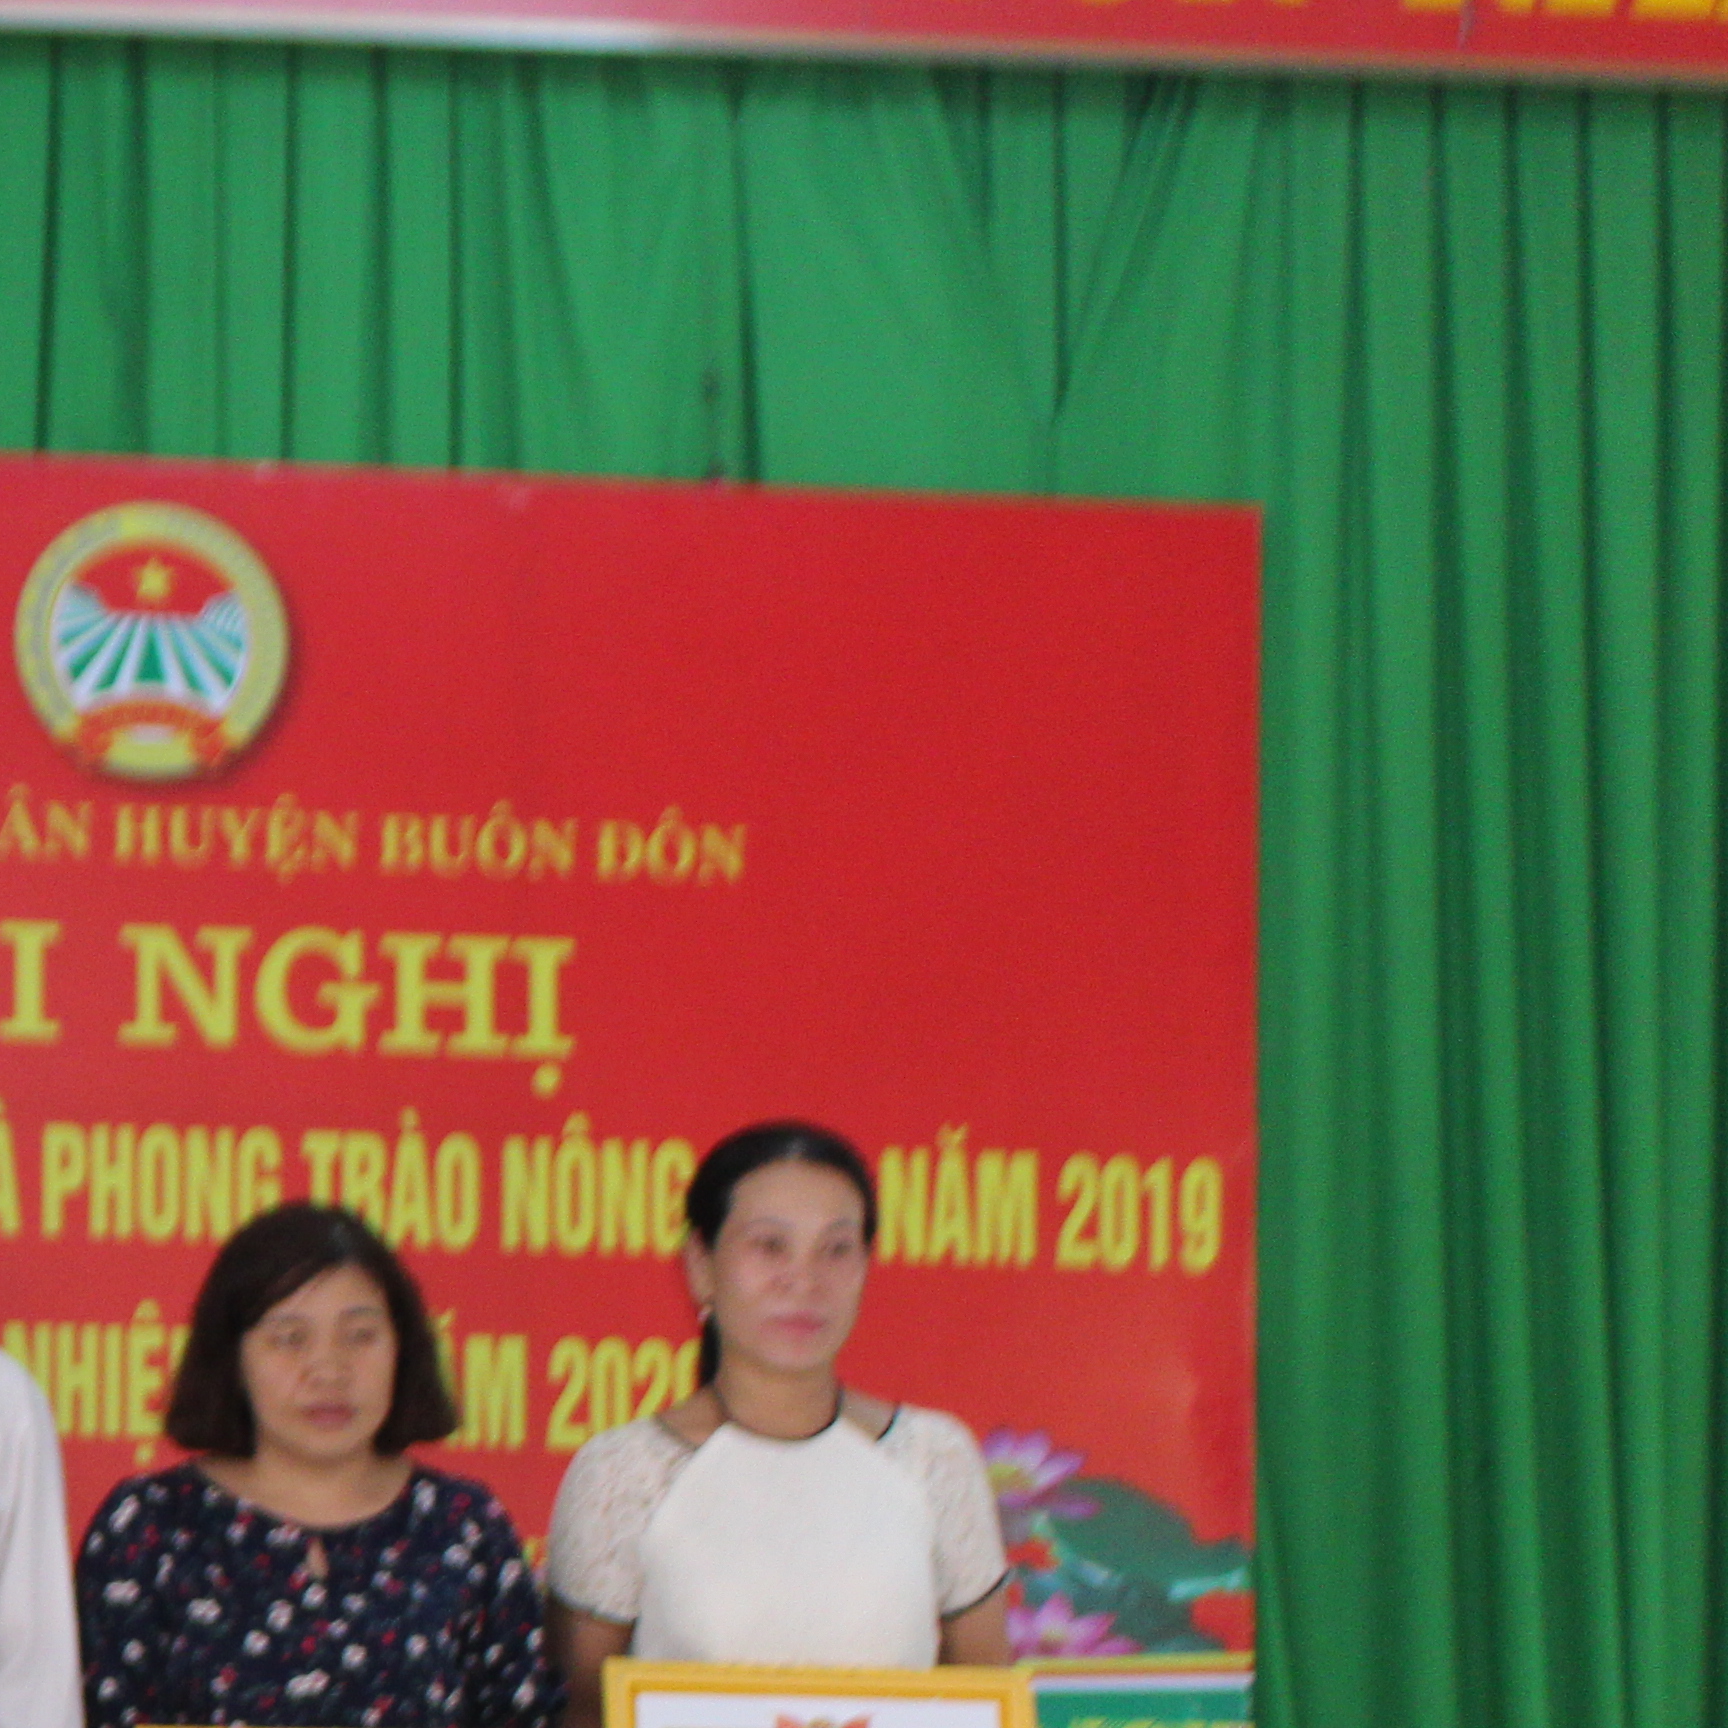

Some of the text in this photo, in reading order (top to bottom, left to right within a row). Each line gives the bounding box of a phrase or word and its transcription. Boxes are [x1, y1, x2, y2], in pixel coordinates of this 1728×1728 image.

[113, 792, 360, 884] HUYỆN
[379, 800, 578, 879] BUÔN
[116, 923, 577, 1098] NGHỊ
[38, 1120, 285, 1250] PHONG
[299, 1106, 484, 1255] TRÀO
[499, 1112, 700, 1258] NÔNG
[875, 1124, 1041, 1270] NĂM
[1053, 1151, 1225, 1278] 2019
[0, 1297, 192, 1468] NHIỆ
